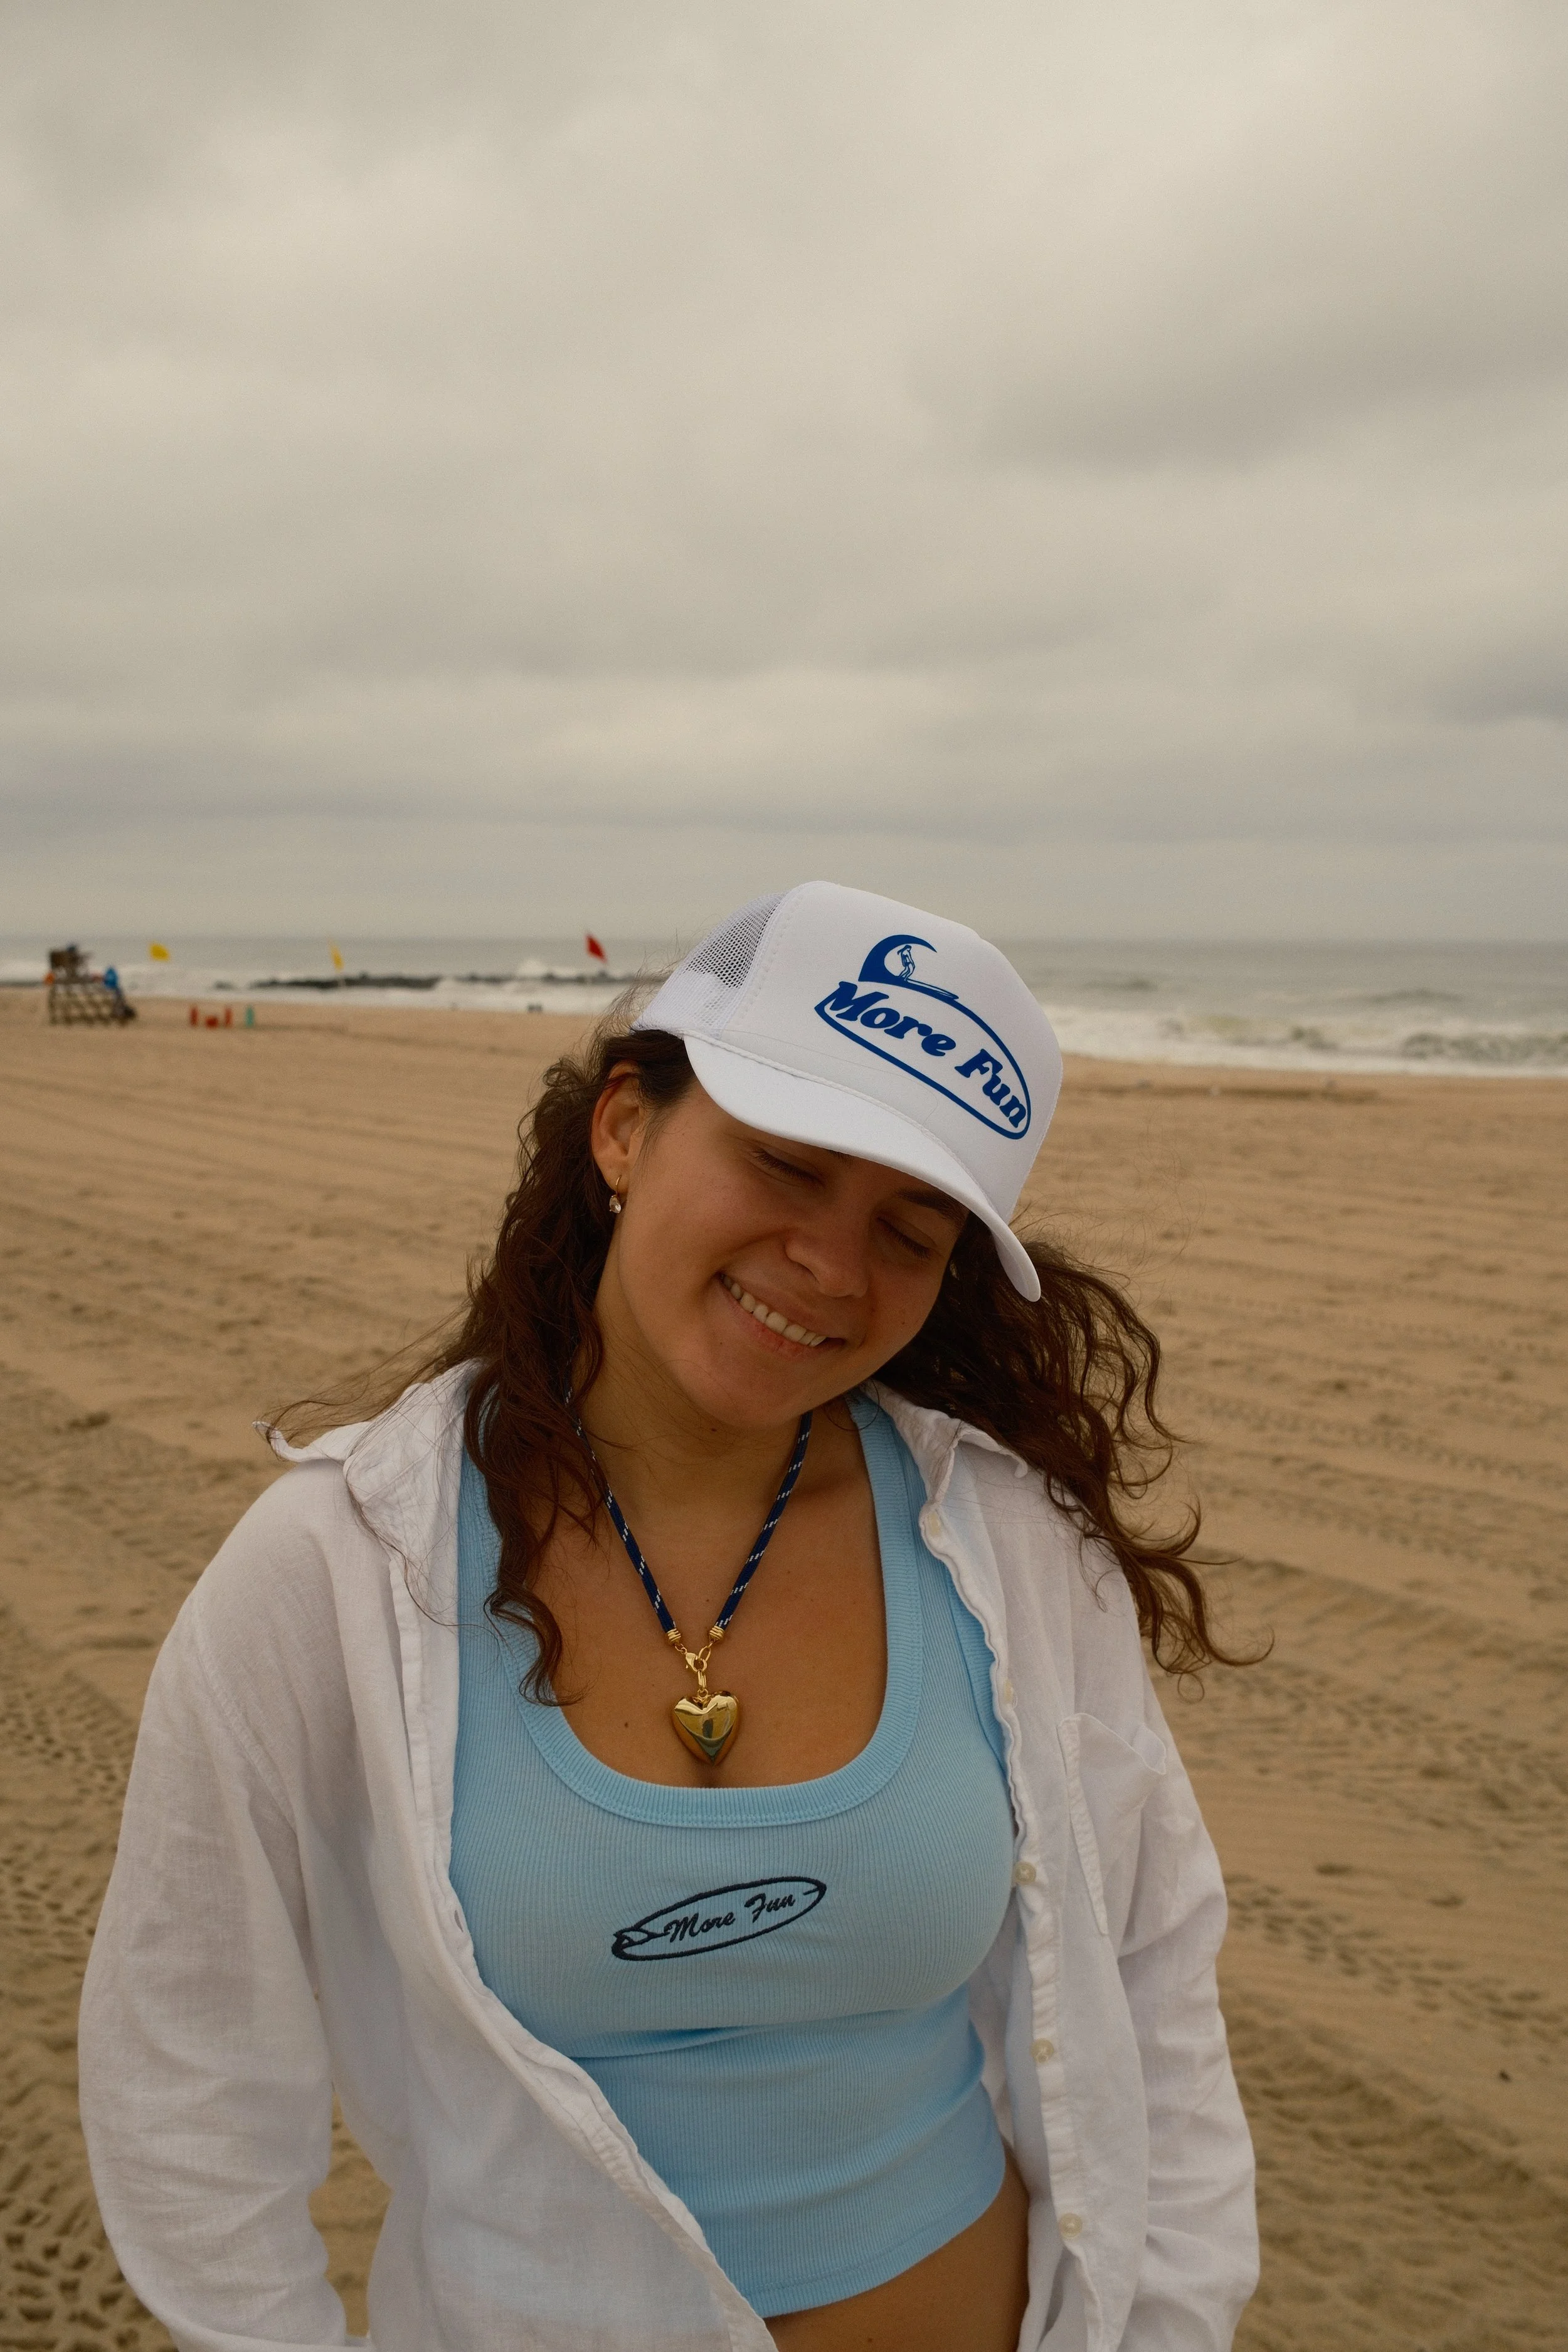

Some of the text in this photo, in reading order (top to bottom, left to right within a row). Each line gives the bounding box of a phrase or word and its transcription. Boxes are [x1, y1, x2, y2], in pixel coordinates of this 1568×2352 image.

[829, 981, 1027, 1128] More Fun
[664, 1893, 796, 1943] More Fun
